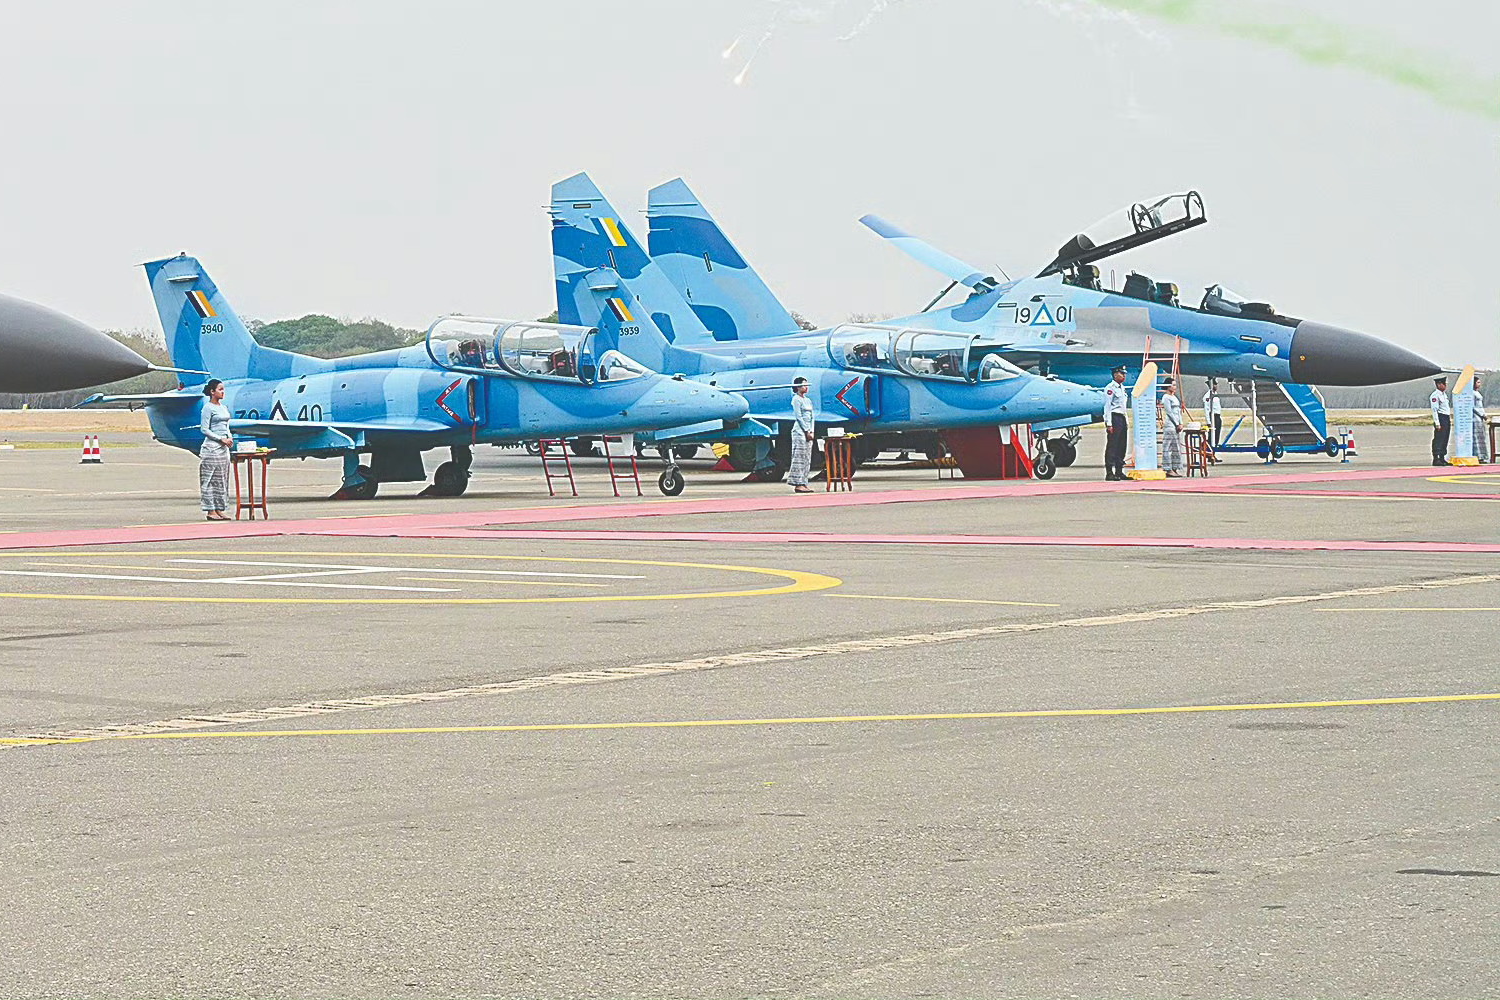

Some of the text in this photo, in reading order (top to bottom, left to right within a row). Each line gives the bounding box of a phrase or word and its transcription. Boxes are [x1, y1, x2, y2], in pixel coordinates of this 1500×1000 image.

[1014, 305, 1073, 324] 19 01
[201, 323, 224, 335] 3940
[619, 326, 640, 337] 3939
